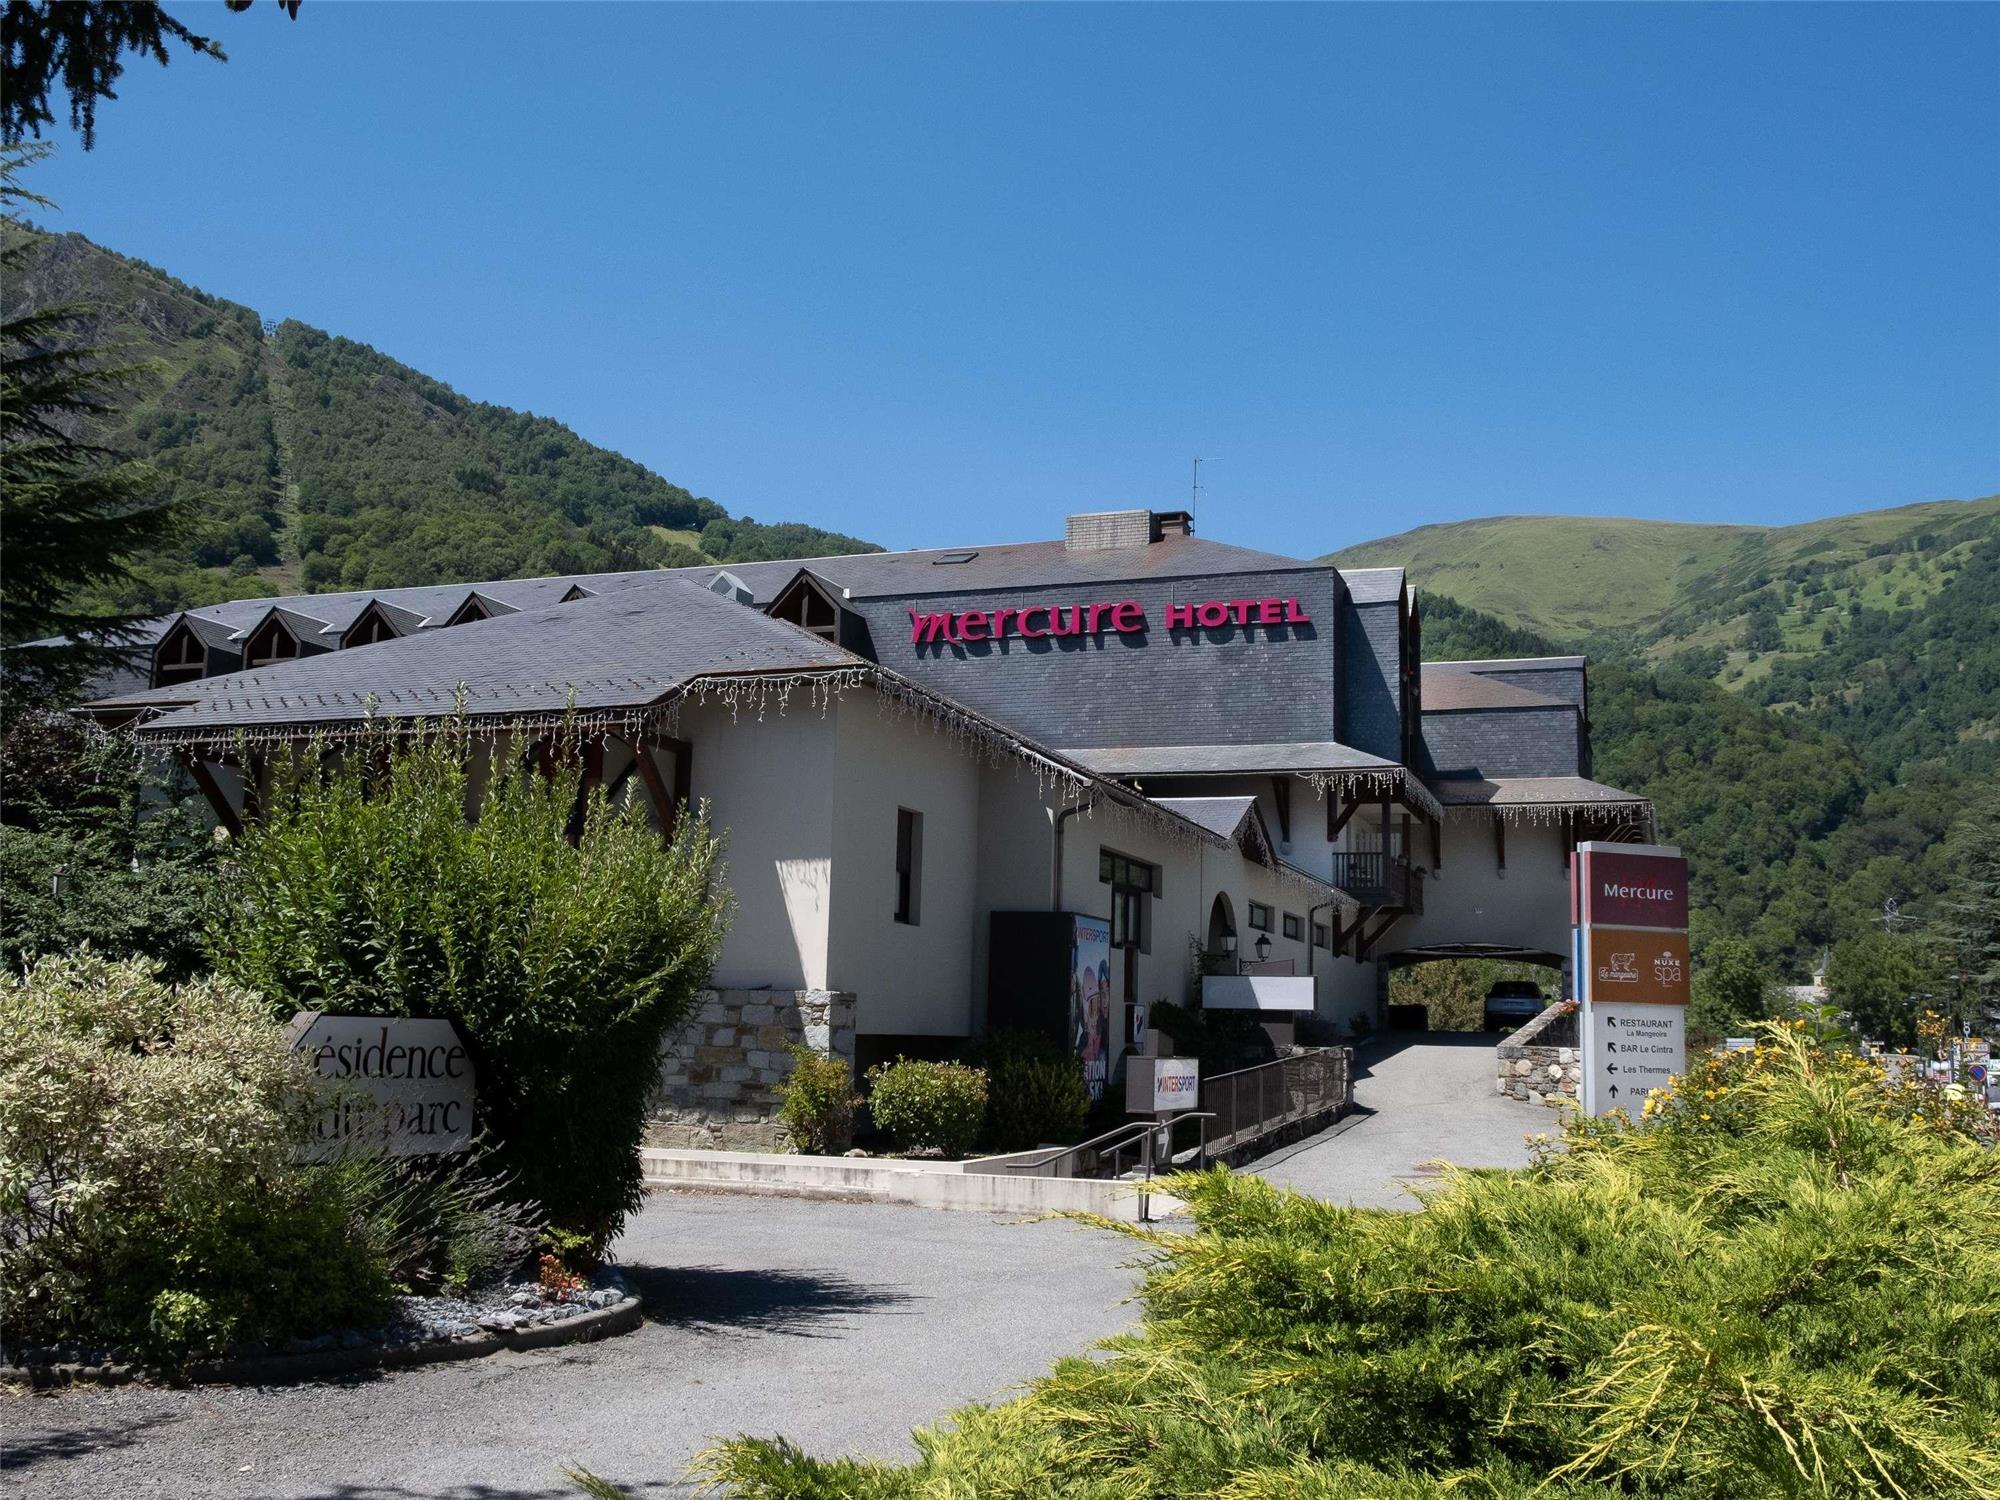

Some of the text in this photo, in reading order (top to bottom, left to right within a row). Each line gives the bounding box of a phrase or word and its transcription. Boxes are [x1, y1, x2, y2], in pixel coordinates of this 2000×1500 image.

[908, 597, 1311, 644] mercure HOTEL
[1604, 883, 1674, 901] Mercure
[1076, 927, 1108, 943] INTERSPORT
[1654, 959, 1681, 967] NUXE
[1654, 966, 1682, 985] spa
[1620, 1018, 1673, 1029] RESTAURANT
[1635, 1030, 1667, 1039] Mangeoire
[302, 1026, 466, 1080] ésidence
[1620, 1044, 1673, 1054] BAR Le Cintra
[1623, 1065, 1671, 1075] Les Thermes
[1161, 1075, 1195, 1092] INTERSPORT
